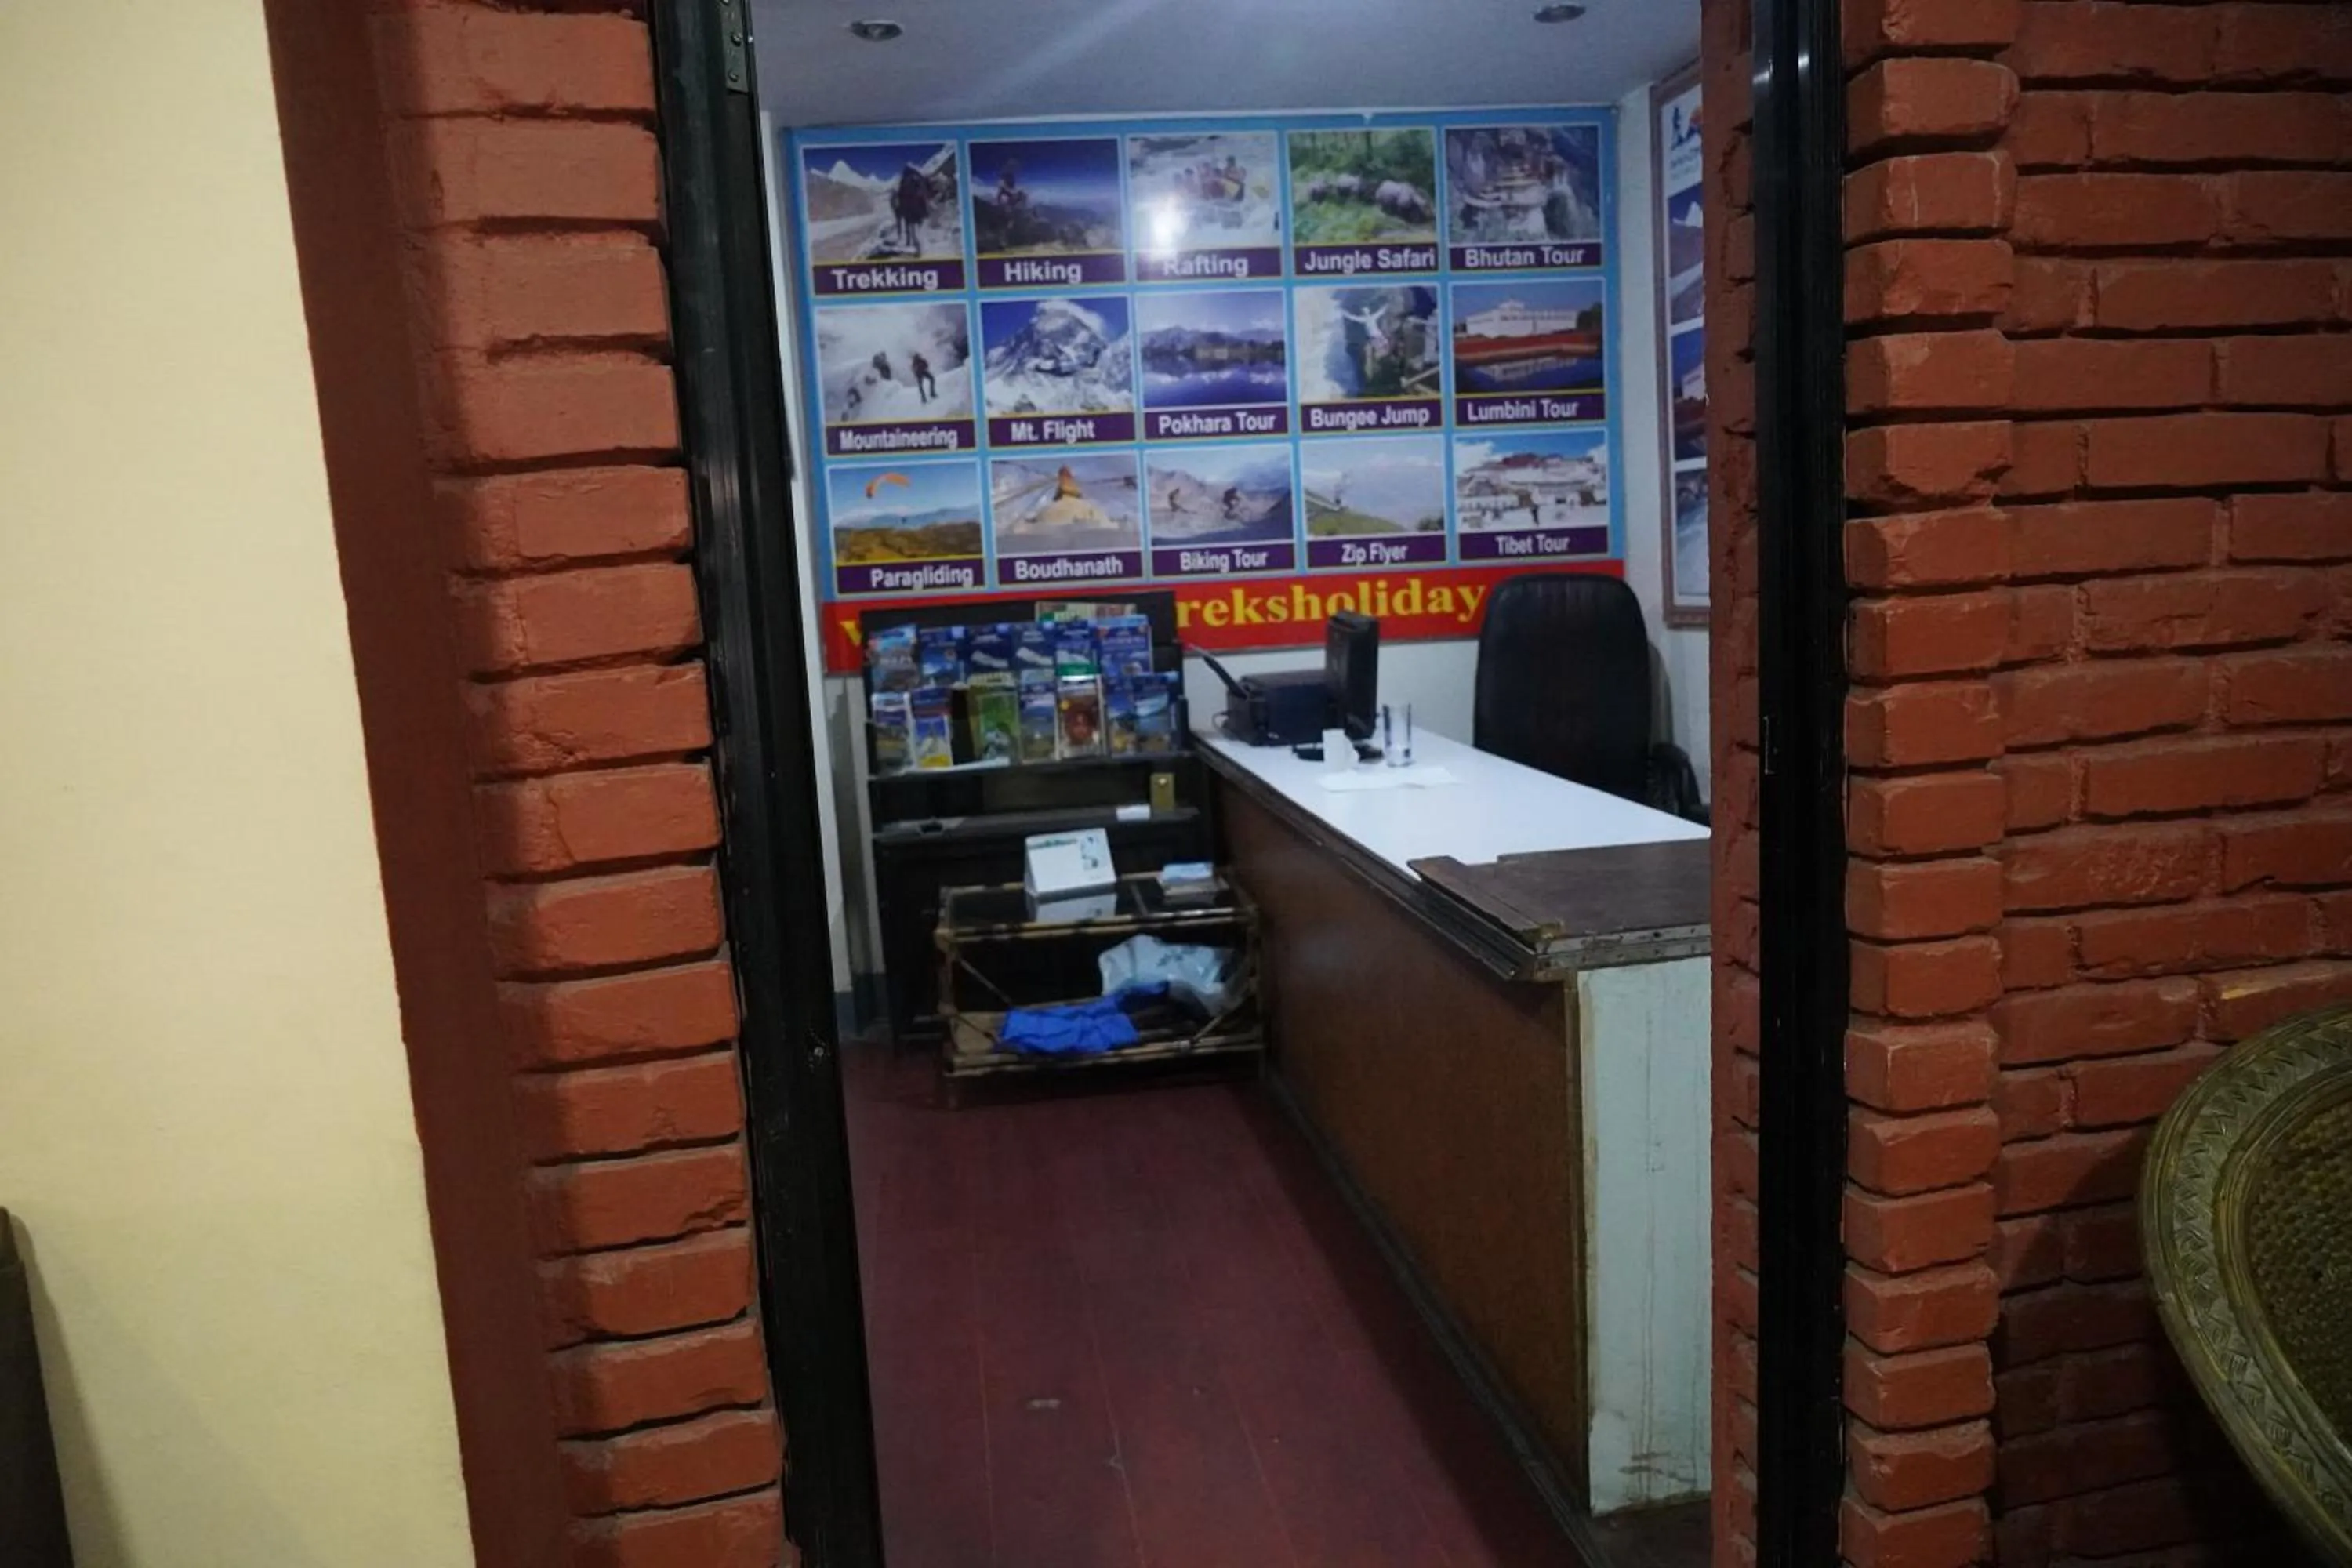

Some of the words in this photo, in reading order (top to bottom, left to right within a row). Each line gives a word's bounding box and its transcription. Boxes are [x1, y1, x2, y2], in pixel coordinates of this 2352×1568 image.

[1163, 254, 1249, 278] Rafting
[1305, 249, 1372, 273] Jungle
[1377, 248, 1436, 268] Safari
[1465, 247, 1534, 268] Bhutan
[1541, 245, 1584, 264] Tour
[831, 268, 938, 290] Trekking
[1004, 260, 1082, 283] Hiking
[1310, 408, 1377, 431] Bungee
[1381, 406, 1430, 428] Jump
[1468, 401, 1535, 422] Lumbini
[1539, 399, 1579, 418] Tour
[1011, 424, 1039, 441] Mt.
[1044, 419, 1095, 444] Flight
[1159, 414, 1232, 434] Pokhara
[1236, 412, 1276, 431] Tour
[840, 427, 958, 451] Mountaineering
[1341, 544, 1367, 563] Zip
[1369, 539, 1408, 562] Flyer
[1495, 536, 1531, 555] Tibet
[1534, 534, 1570, 552] Tour
[1014, 557, 1123, 580] Boudhanath
[1180, 551, 1229, 574] Biking
[1233, 549, 1268, 568] Tour
[870, 566, 974, 590] Paragliding
